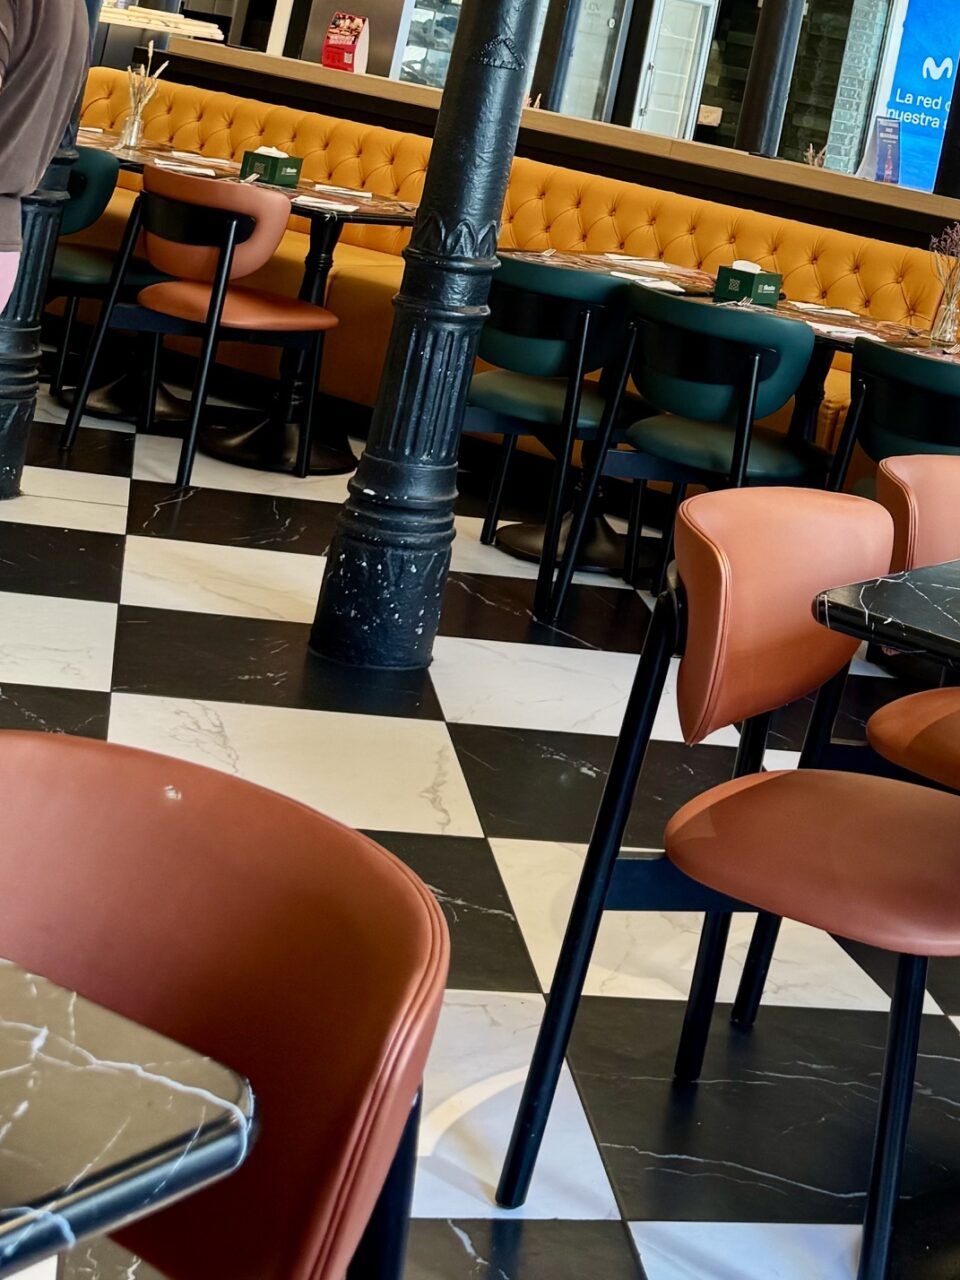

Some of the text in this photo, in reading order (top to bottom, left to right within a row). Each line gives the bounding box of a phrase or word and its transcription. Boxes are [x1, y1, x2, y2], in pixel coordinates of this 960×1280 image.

[895, 88, 913, 104] La
[916, 95, 942, 110] red
[887, 109, 940, 128] nuestra
